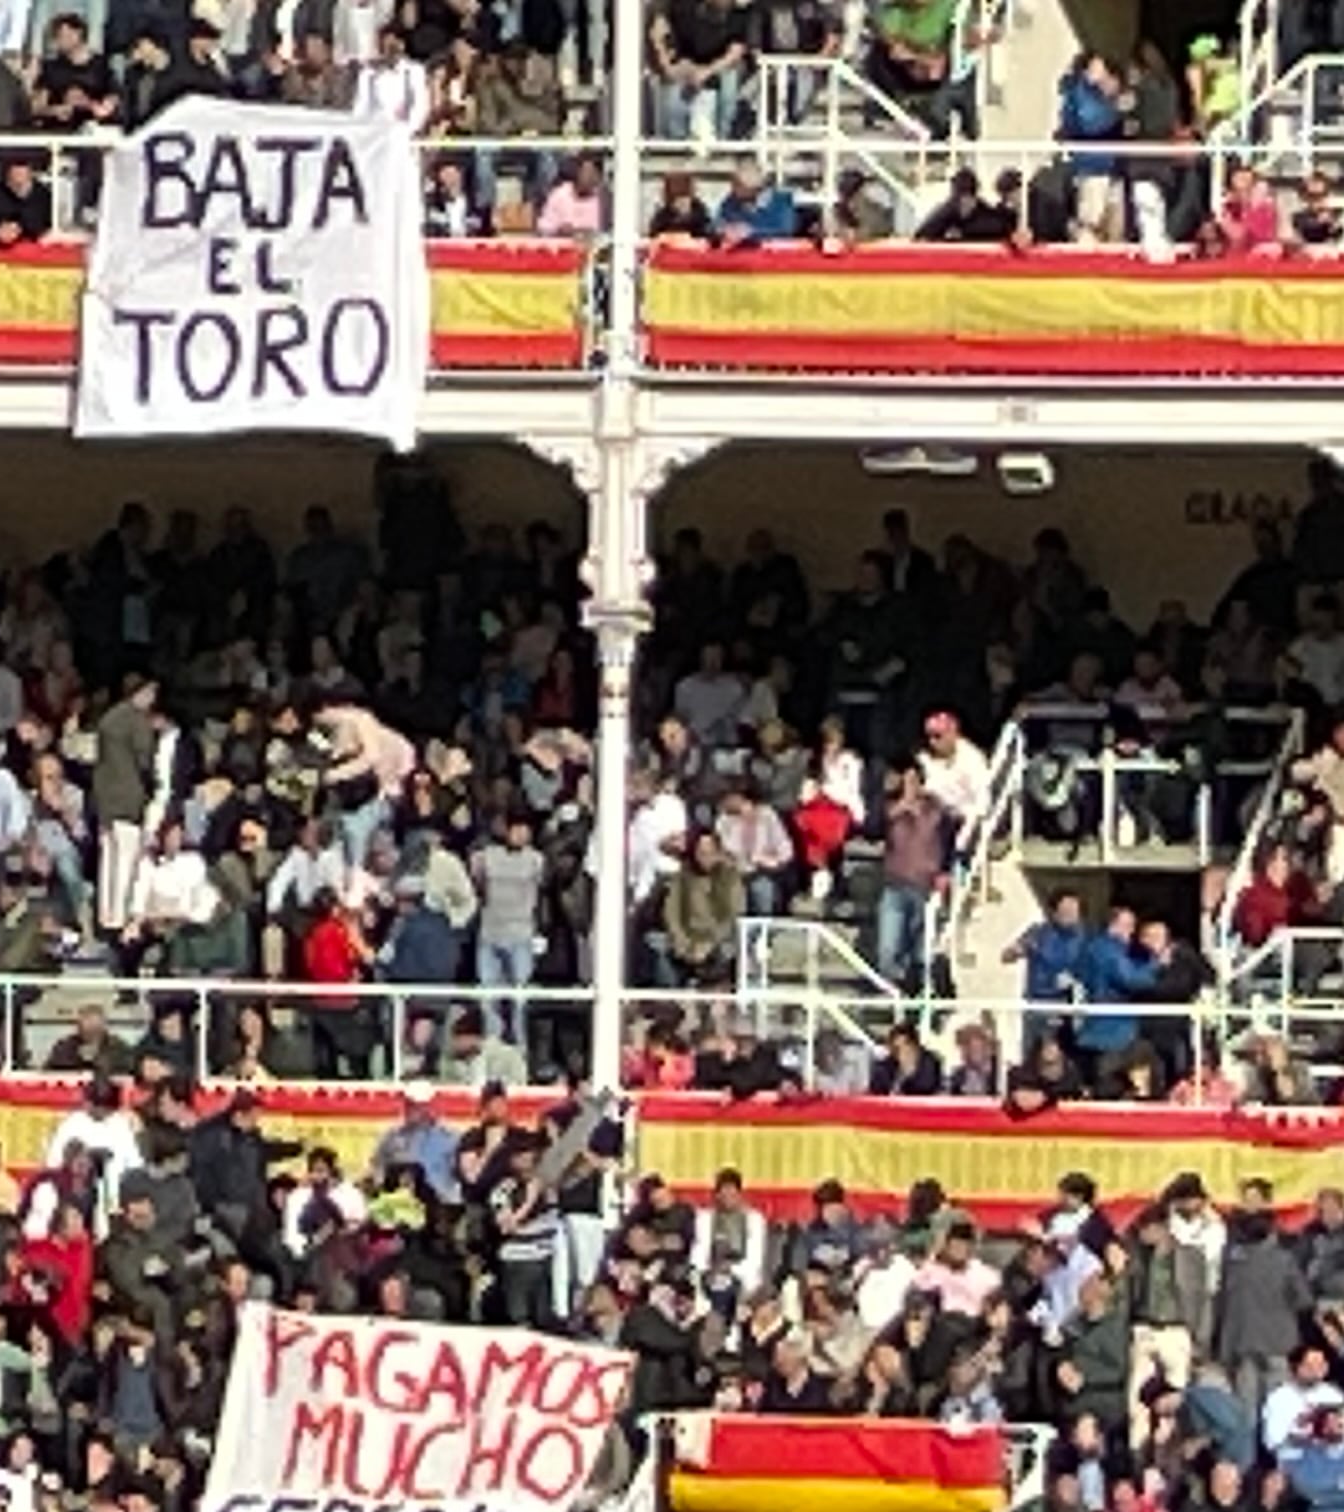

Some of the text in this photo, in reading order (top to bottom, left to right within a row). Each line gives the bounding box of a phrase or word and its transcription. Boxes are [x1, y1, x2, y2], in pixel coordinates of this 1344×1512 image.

[142, 130, 369, 230] BAJA
[209, 237, 293, 295] EL
[113, 298, 390, 404] TORO
[264, 1308, 629, 1429] PAGAMOS
[282, 1401, 584, 1501] MUCHO
